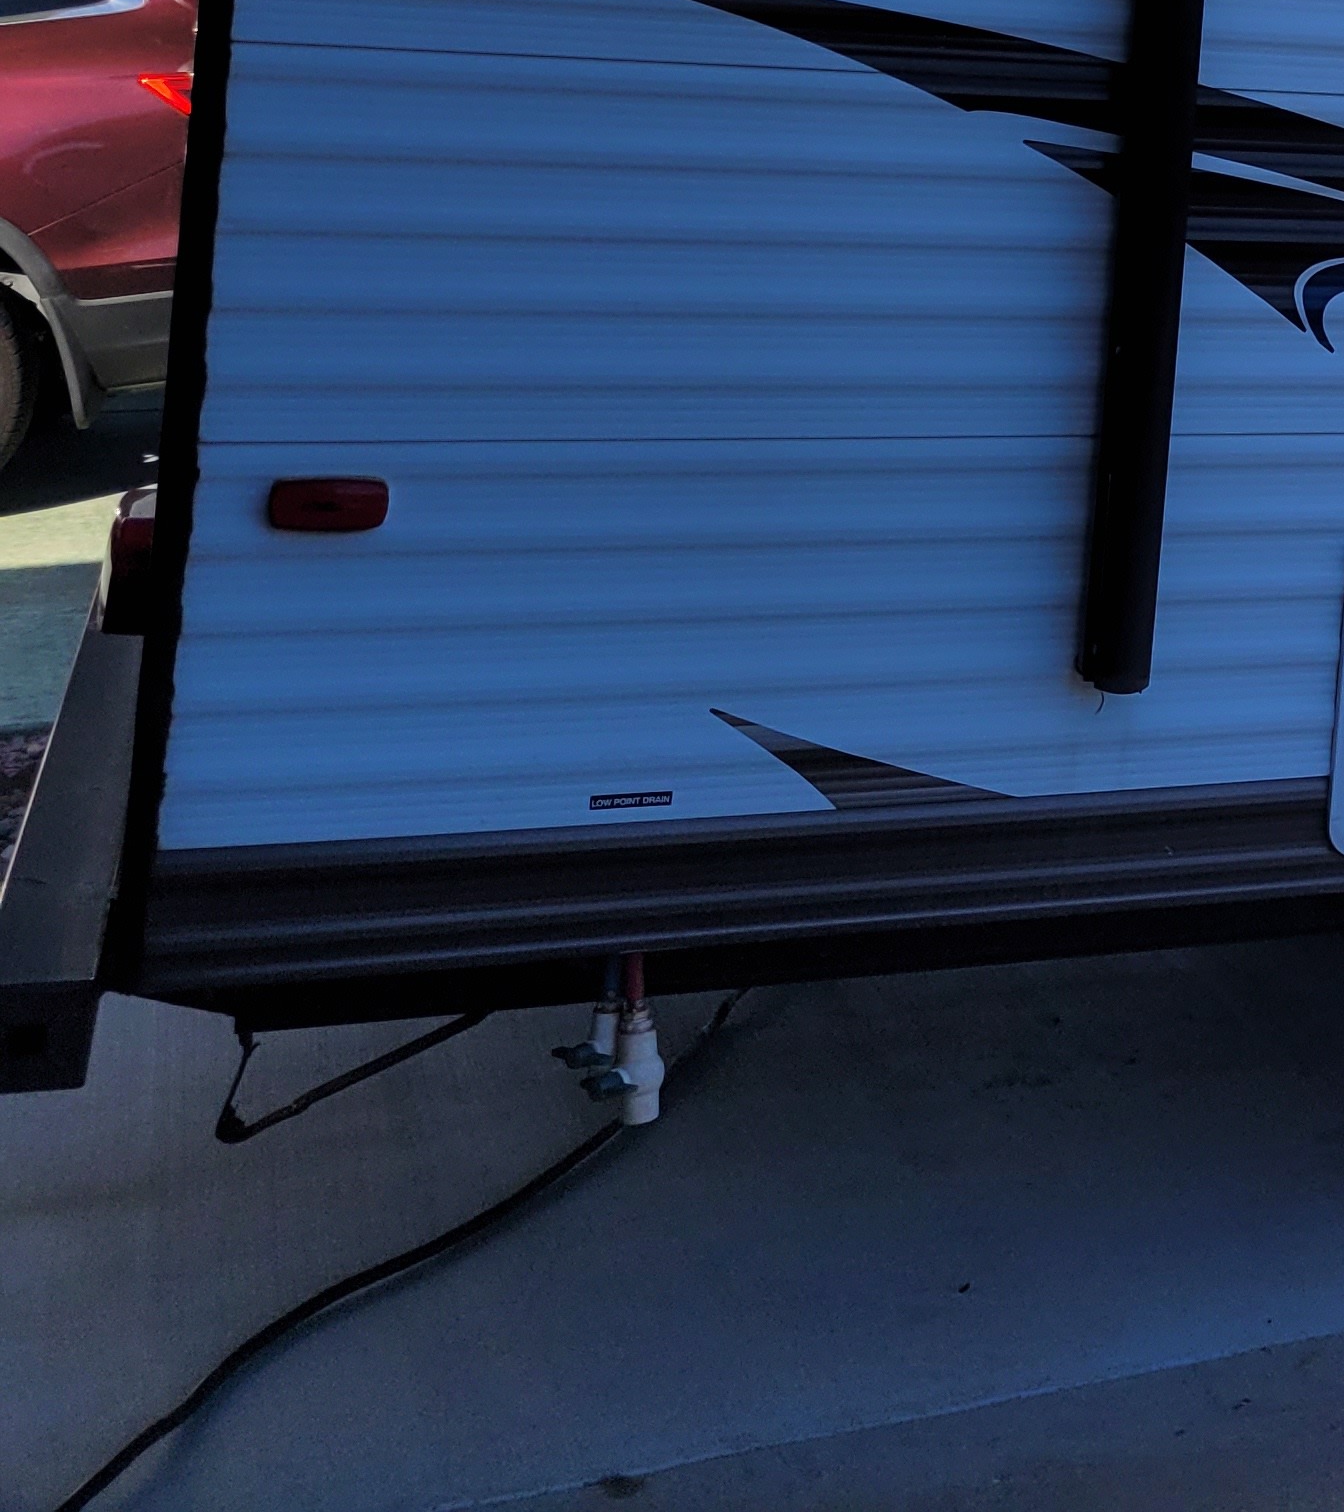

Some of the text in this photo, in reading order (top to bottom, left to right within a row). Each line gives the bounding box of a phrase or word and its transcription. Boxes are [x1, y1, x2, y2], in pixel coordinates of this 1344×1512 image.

[591, 795, 670, 807] LOW POINT DRAIN
